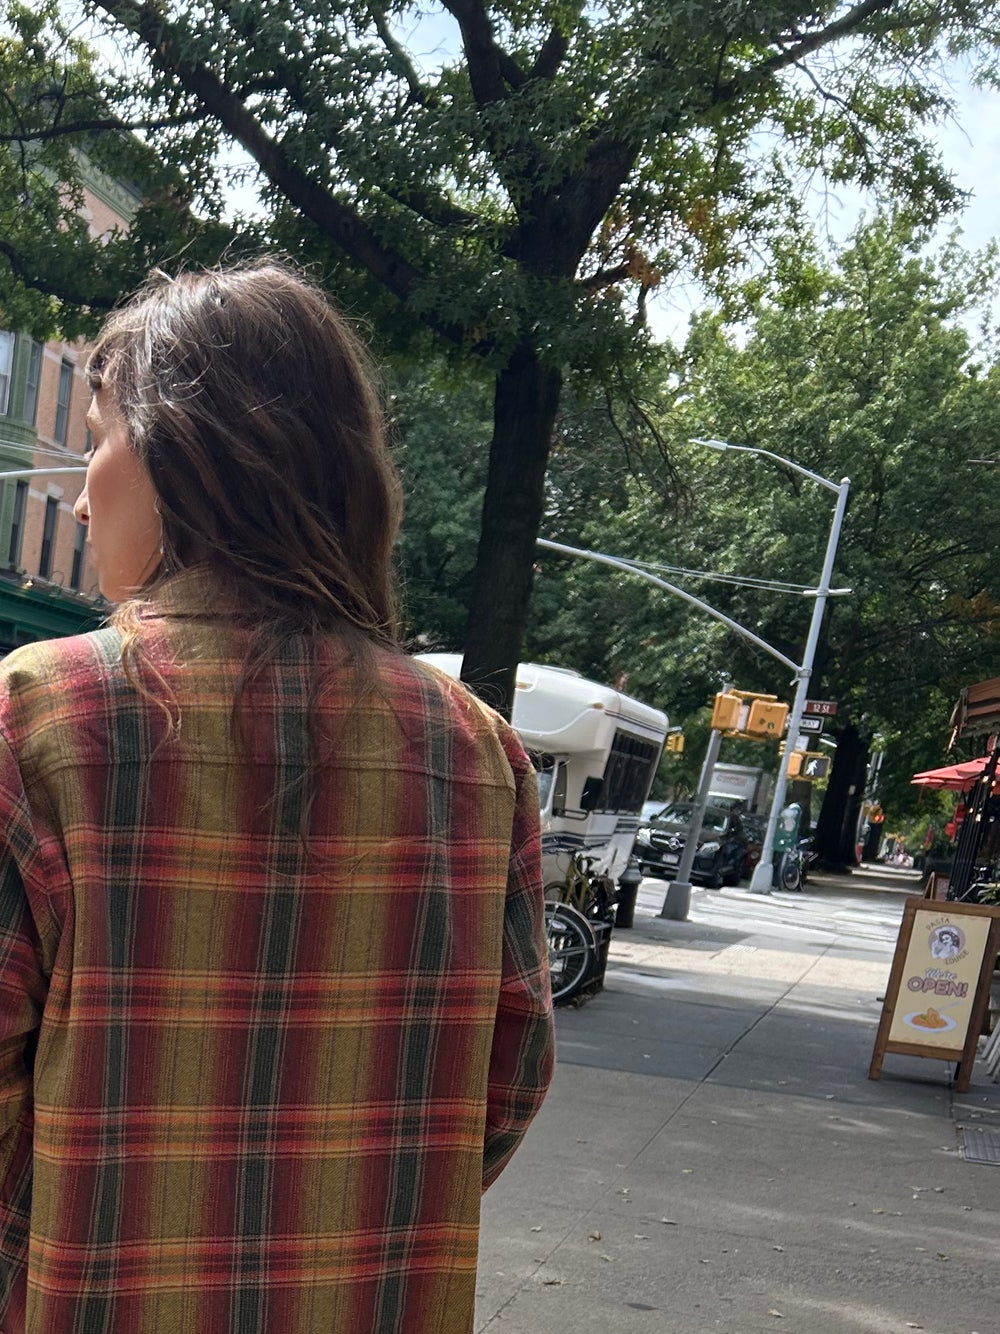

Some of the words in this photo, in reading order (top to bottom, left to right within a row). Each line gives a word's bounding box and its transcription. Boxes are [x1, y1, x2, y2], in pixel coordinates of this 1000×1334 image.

[813, 704, 820, 713] 12
[925, 917, 950, 931] PASTA
[907, 976, 969, 998] OPEN!
